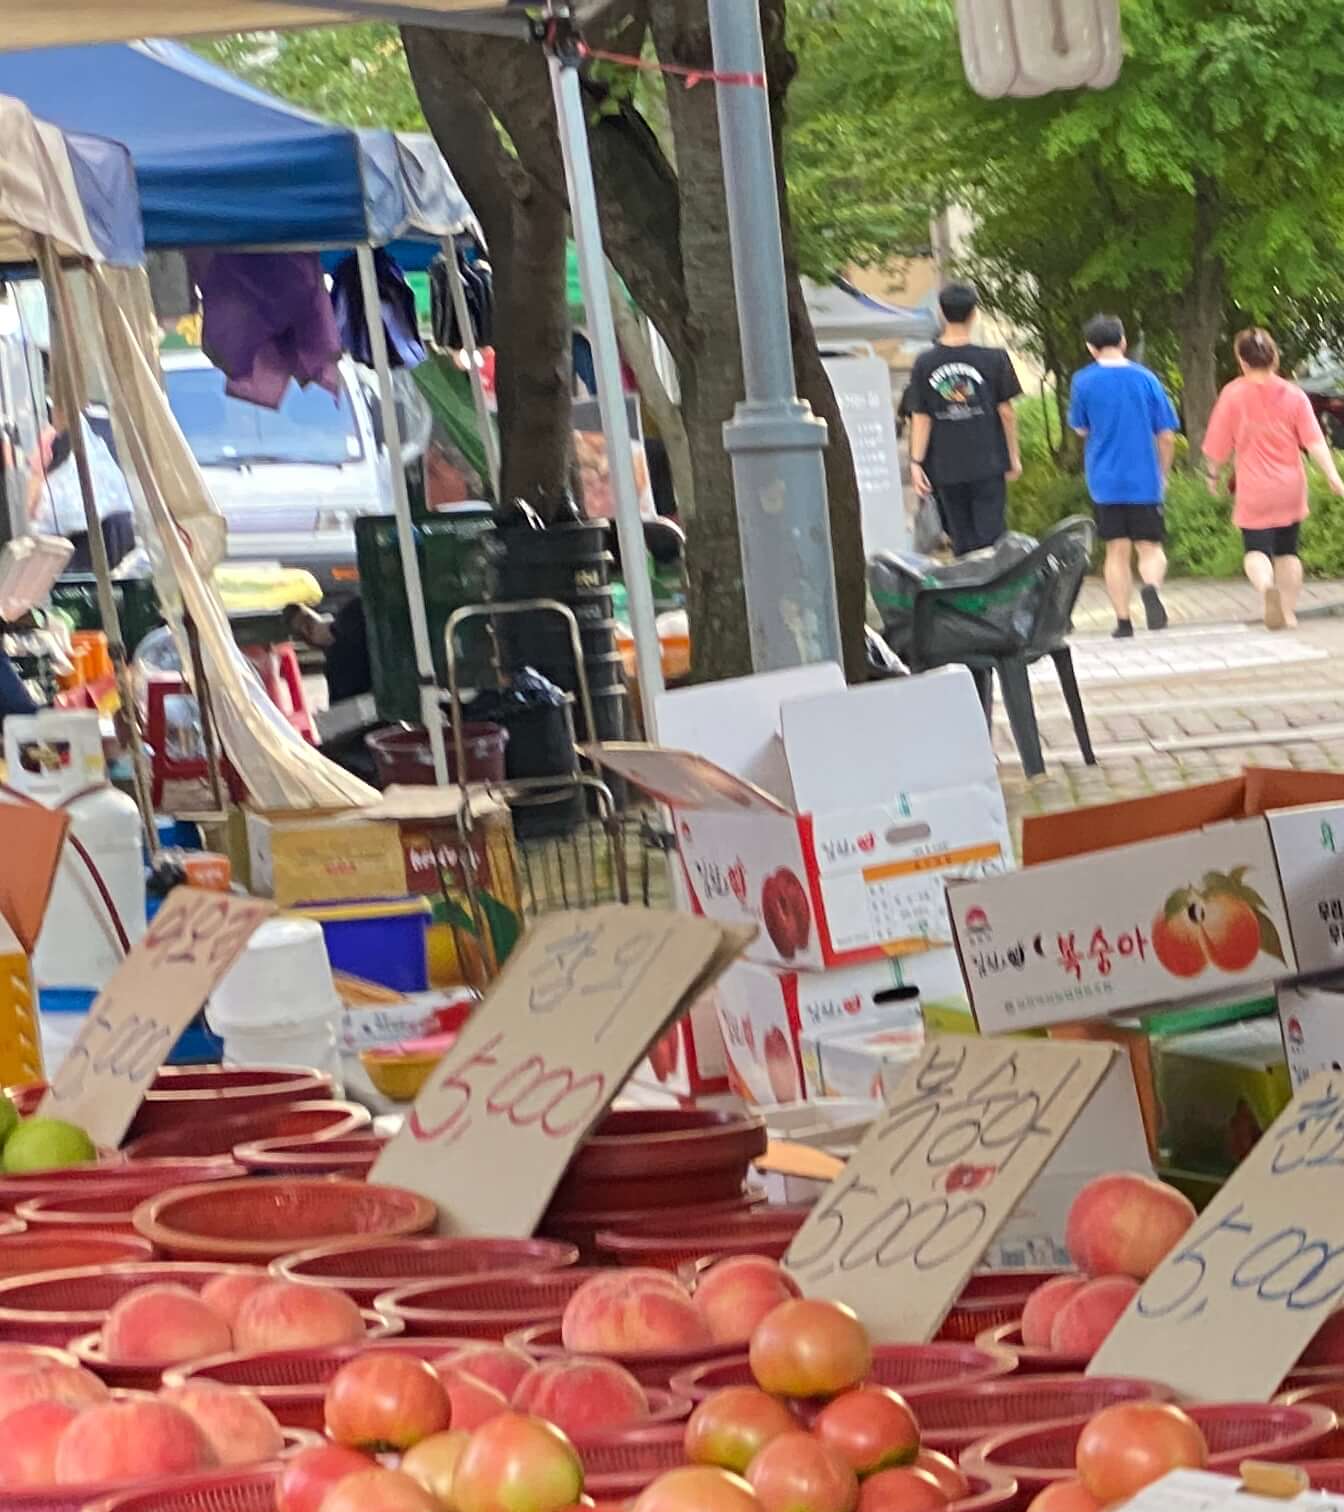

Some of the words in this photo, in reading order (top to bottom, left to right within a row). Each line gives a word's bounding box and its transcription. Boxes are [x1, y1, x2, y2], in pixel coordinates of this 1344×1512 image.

[1056, 924, 1150, 984] 복숭아
[408, 1032, 607, 1146] 5,000
[877, 1042, 1084, 1178] 복숭아
[784, 1175, 988, 1282] 5,000
